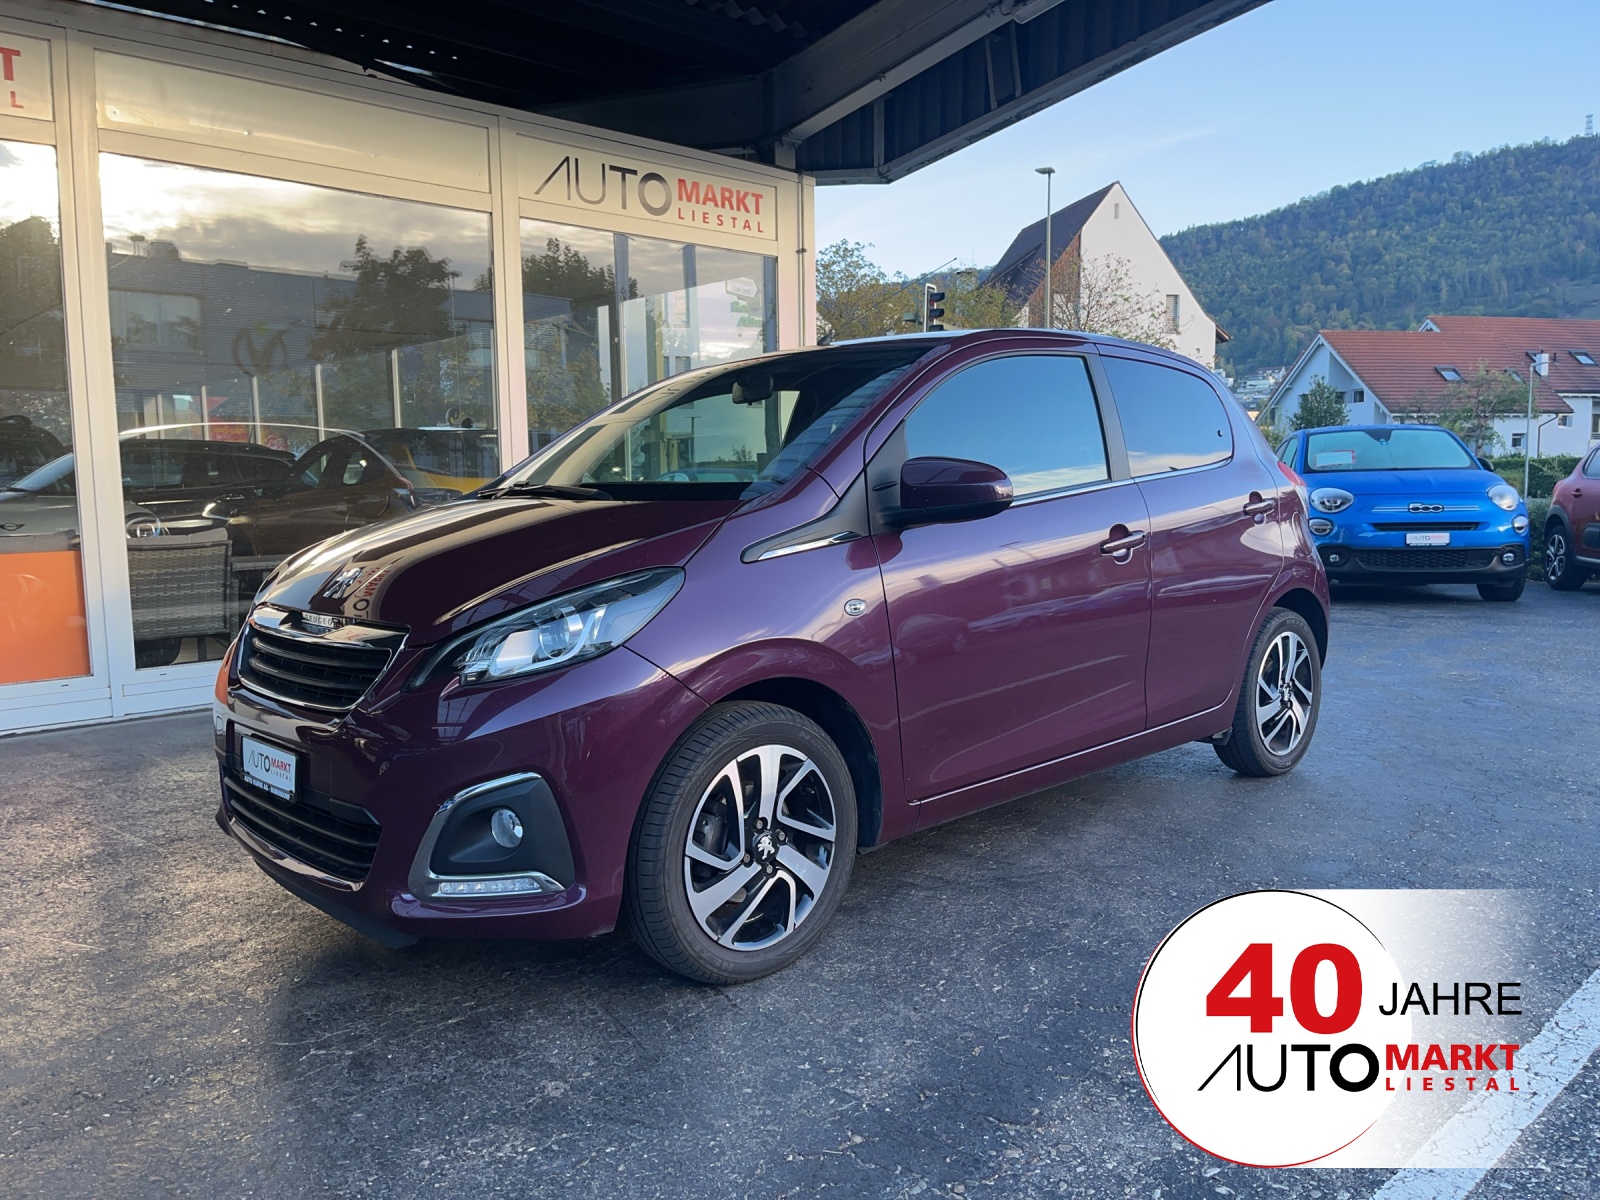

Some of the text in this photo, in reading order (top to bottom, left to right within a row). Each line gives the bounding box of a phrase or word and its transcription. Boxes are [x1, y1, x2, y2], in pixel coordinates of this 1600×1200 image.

[677, 178, 764, 215] MARKT
[677, 207, 764, 233] LIESTAL
[1409, 502, 1443, 513] 500
[304, 613, 338, 628] PEUGEO
